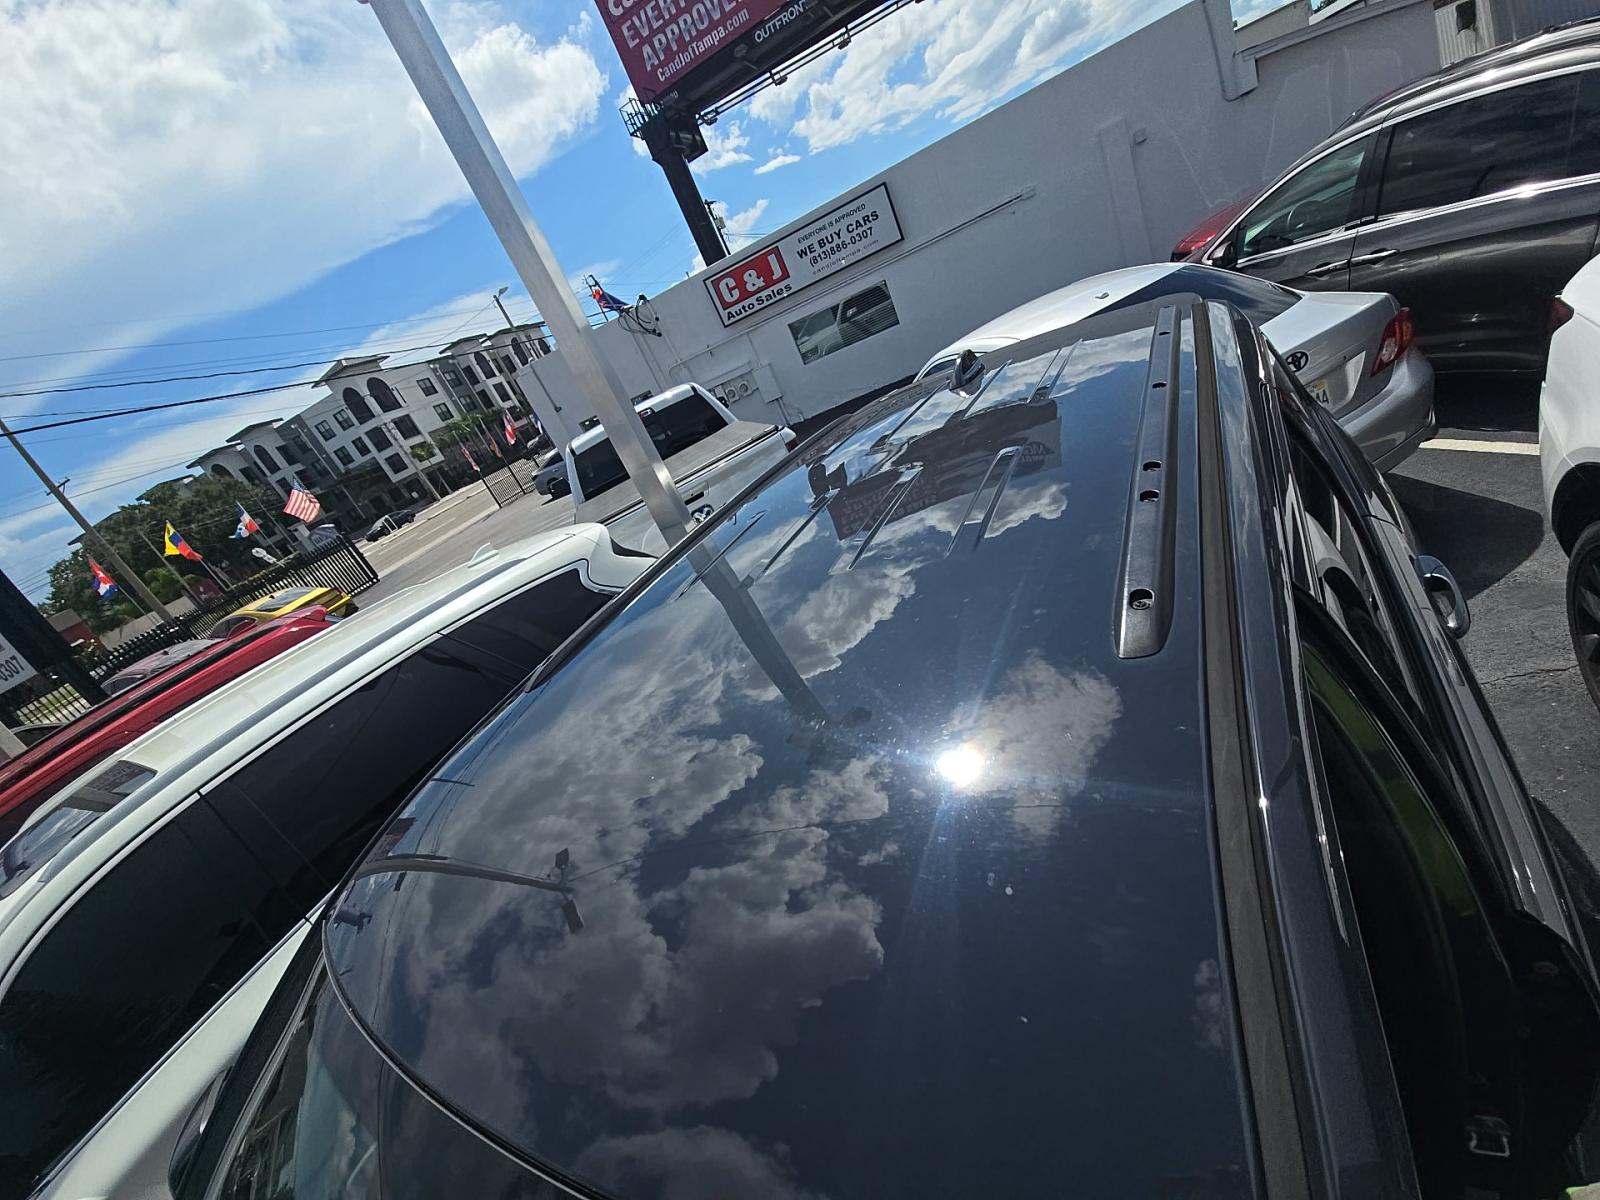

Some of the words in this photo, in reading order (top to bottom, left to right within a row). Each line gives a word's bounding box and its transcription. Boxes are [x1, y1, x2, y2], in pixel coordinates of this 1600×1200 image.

[621, 0, 686, 49] EVER
[641, 0, 742, 72] APPROVE
[796, 243, 817, 259] WE
[817, 228, 842, 249] BUY
[846, 210, 879, 234] CARS
[797, 223, 827, 244] EVERYONE
[834, 203, 866, 223] APPROVED
[809, 226, 873, 268] (813)886-0307
[718, 277, 740, 303] C
[743, 269, 766, 292] &
[767, 253, 783, 280] J
[726, 302, 755, 321] Auto
[755, 283, 793, 306] Sales
